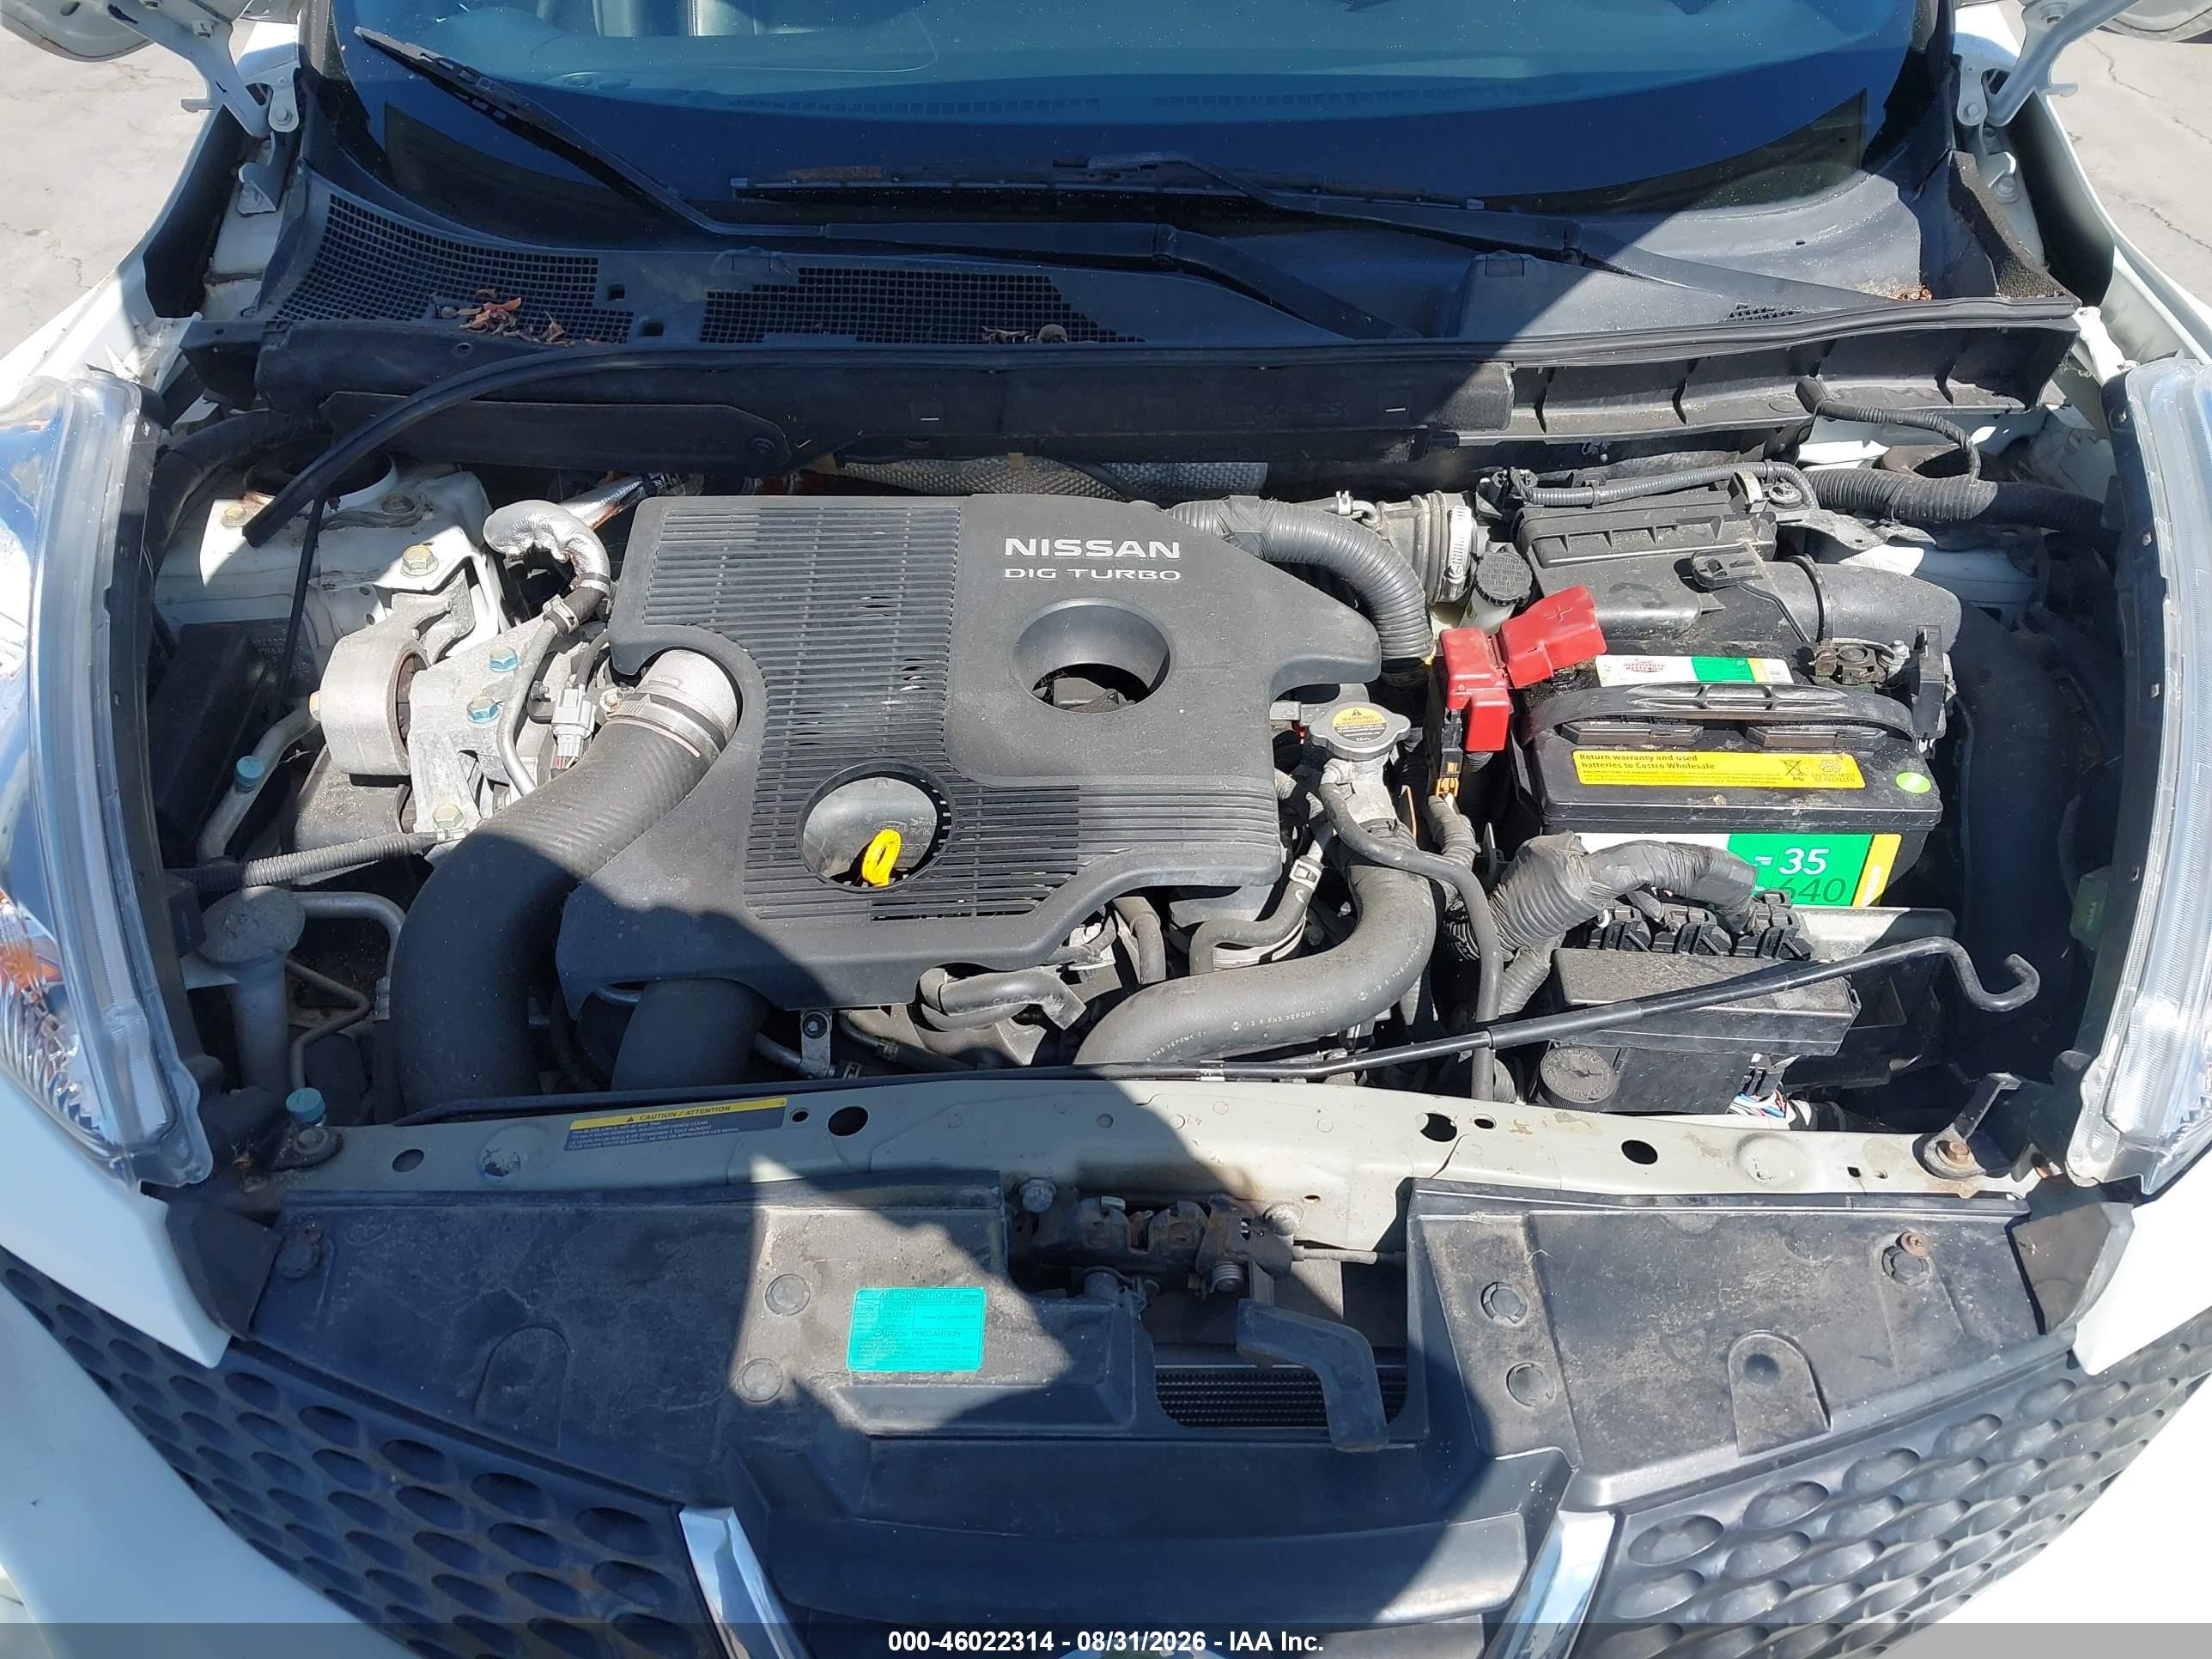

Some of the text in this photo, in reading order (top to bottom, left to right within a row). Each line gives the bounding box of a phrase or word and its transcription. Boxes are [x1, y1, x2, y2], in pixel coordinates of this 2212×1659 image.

[1005, 538, 1181, 560] NISSAN
[1005, 568, 1182, 581] DIG TURBO
[1778, 848, 1830, 875] 35
[1778, 878, 1846, 902] 640
[640, 1111, 677, 1121] CAUTION
[685, 1106, 731, 1116] ATTENTION
